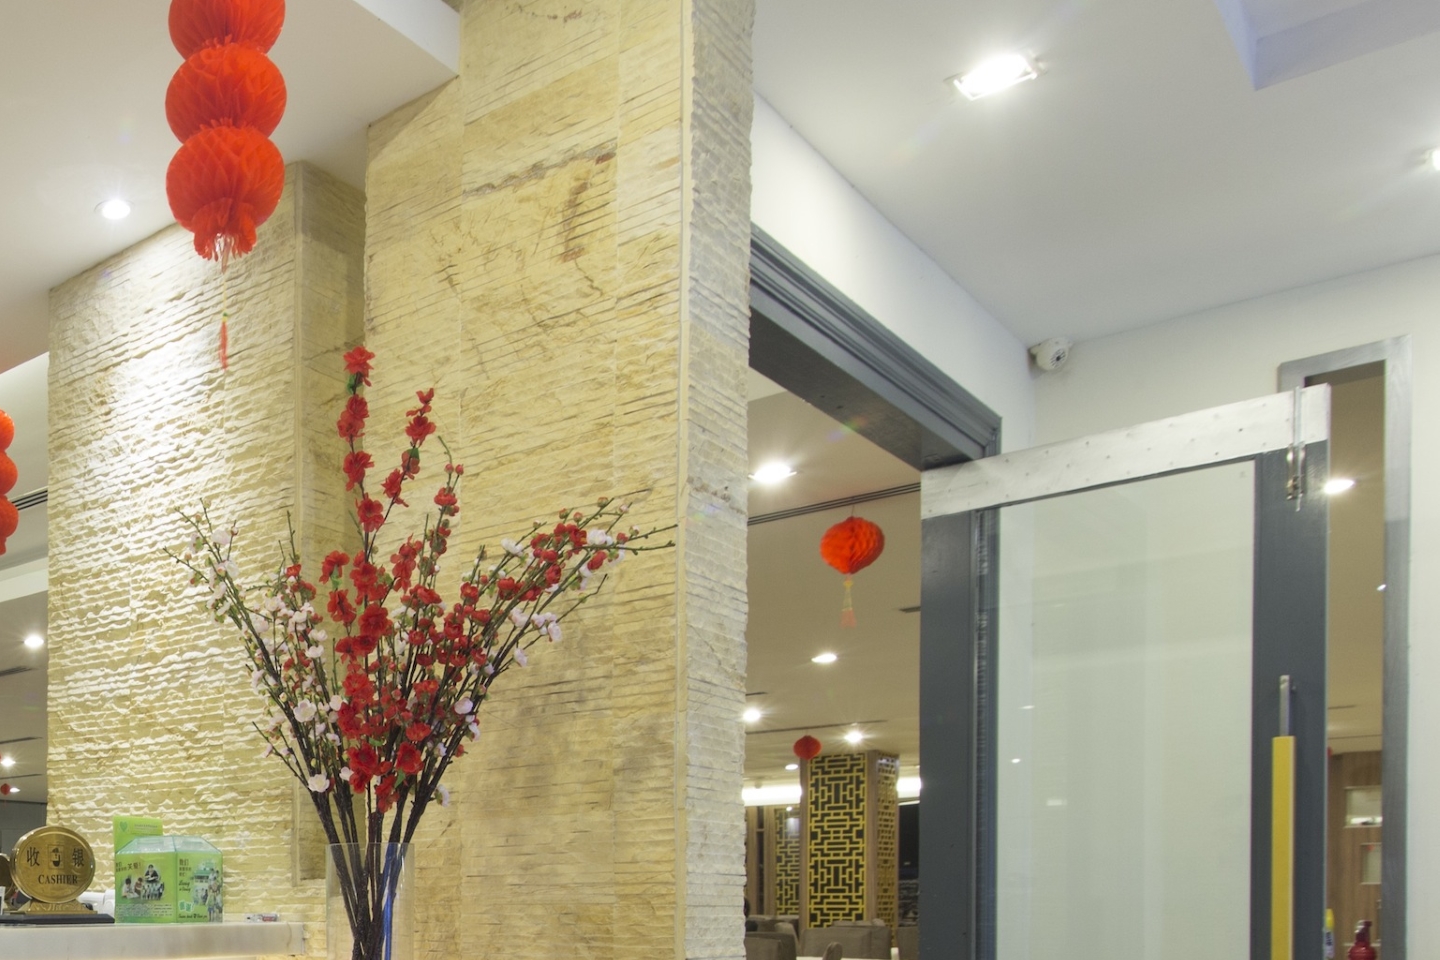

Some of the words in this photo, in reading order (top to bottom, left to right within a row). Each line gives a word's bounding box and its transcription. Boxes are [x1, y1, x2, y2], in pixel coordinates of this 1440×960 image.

[26, 847, 40, 867] 收
[72, 847, 84, 867] 银
[38, 874, 78, 885] CASHIER
